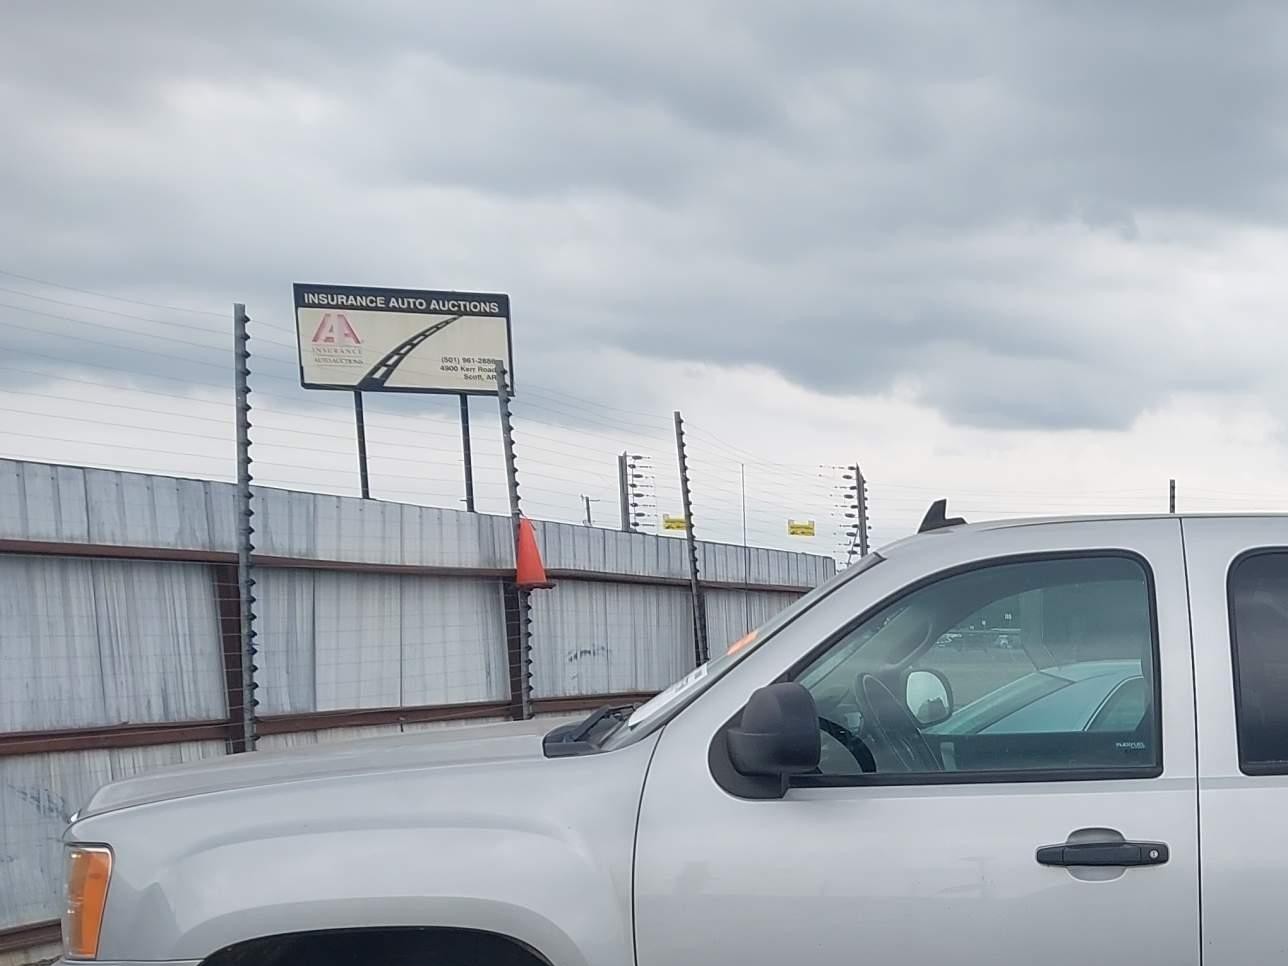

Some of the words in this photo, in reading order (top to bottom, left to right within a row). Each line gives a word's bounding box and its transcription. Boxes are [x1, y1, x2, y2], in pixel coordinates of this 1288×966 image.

[304, 293, 385, 307] INSURANCE
[389, 297, 426, 309] AUTO
[430, 300, 499, 313] AUCTIONS
[441, 356, 460, 365] (501)
[478, 366, 497, 374] Road
